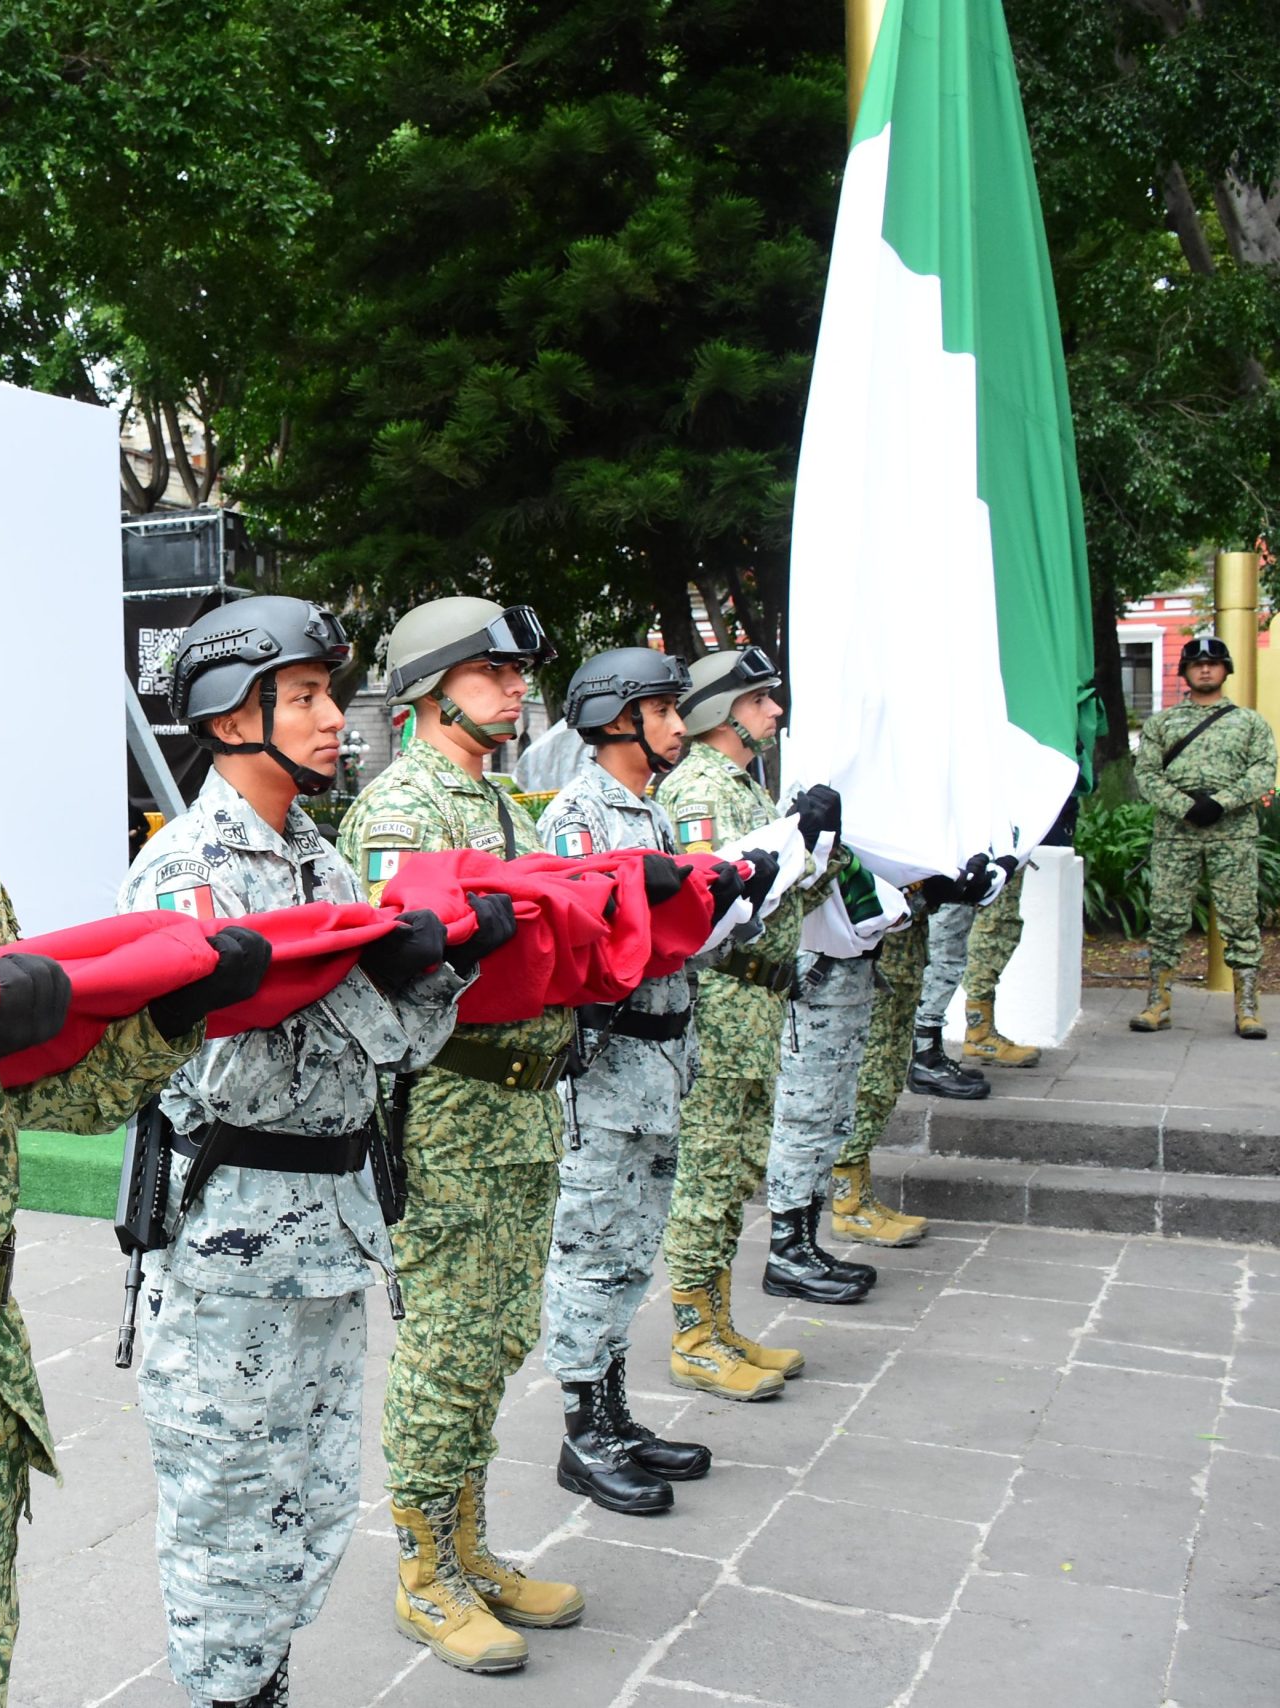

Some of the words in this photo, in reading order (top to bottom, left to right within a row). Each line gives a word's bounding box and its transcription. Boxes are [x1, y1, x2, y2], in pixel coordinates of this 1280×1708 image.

[222, 827, 243, 840] GN
[371, 822, 413, 836] MEXICO
[300, 836, 318, 849] GN
[160, 861, 205, 880] MEXICO
